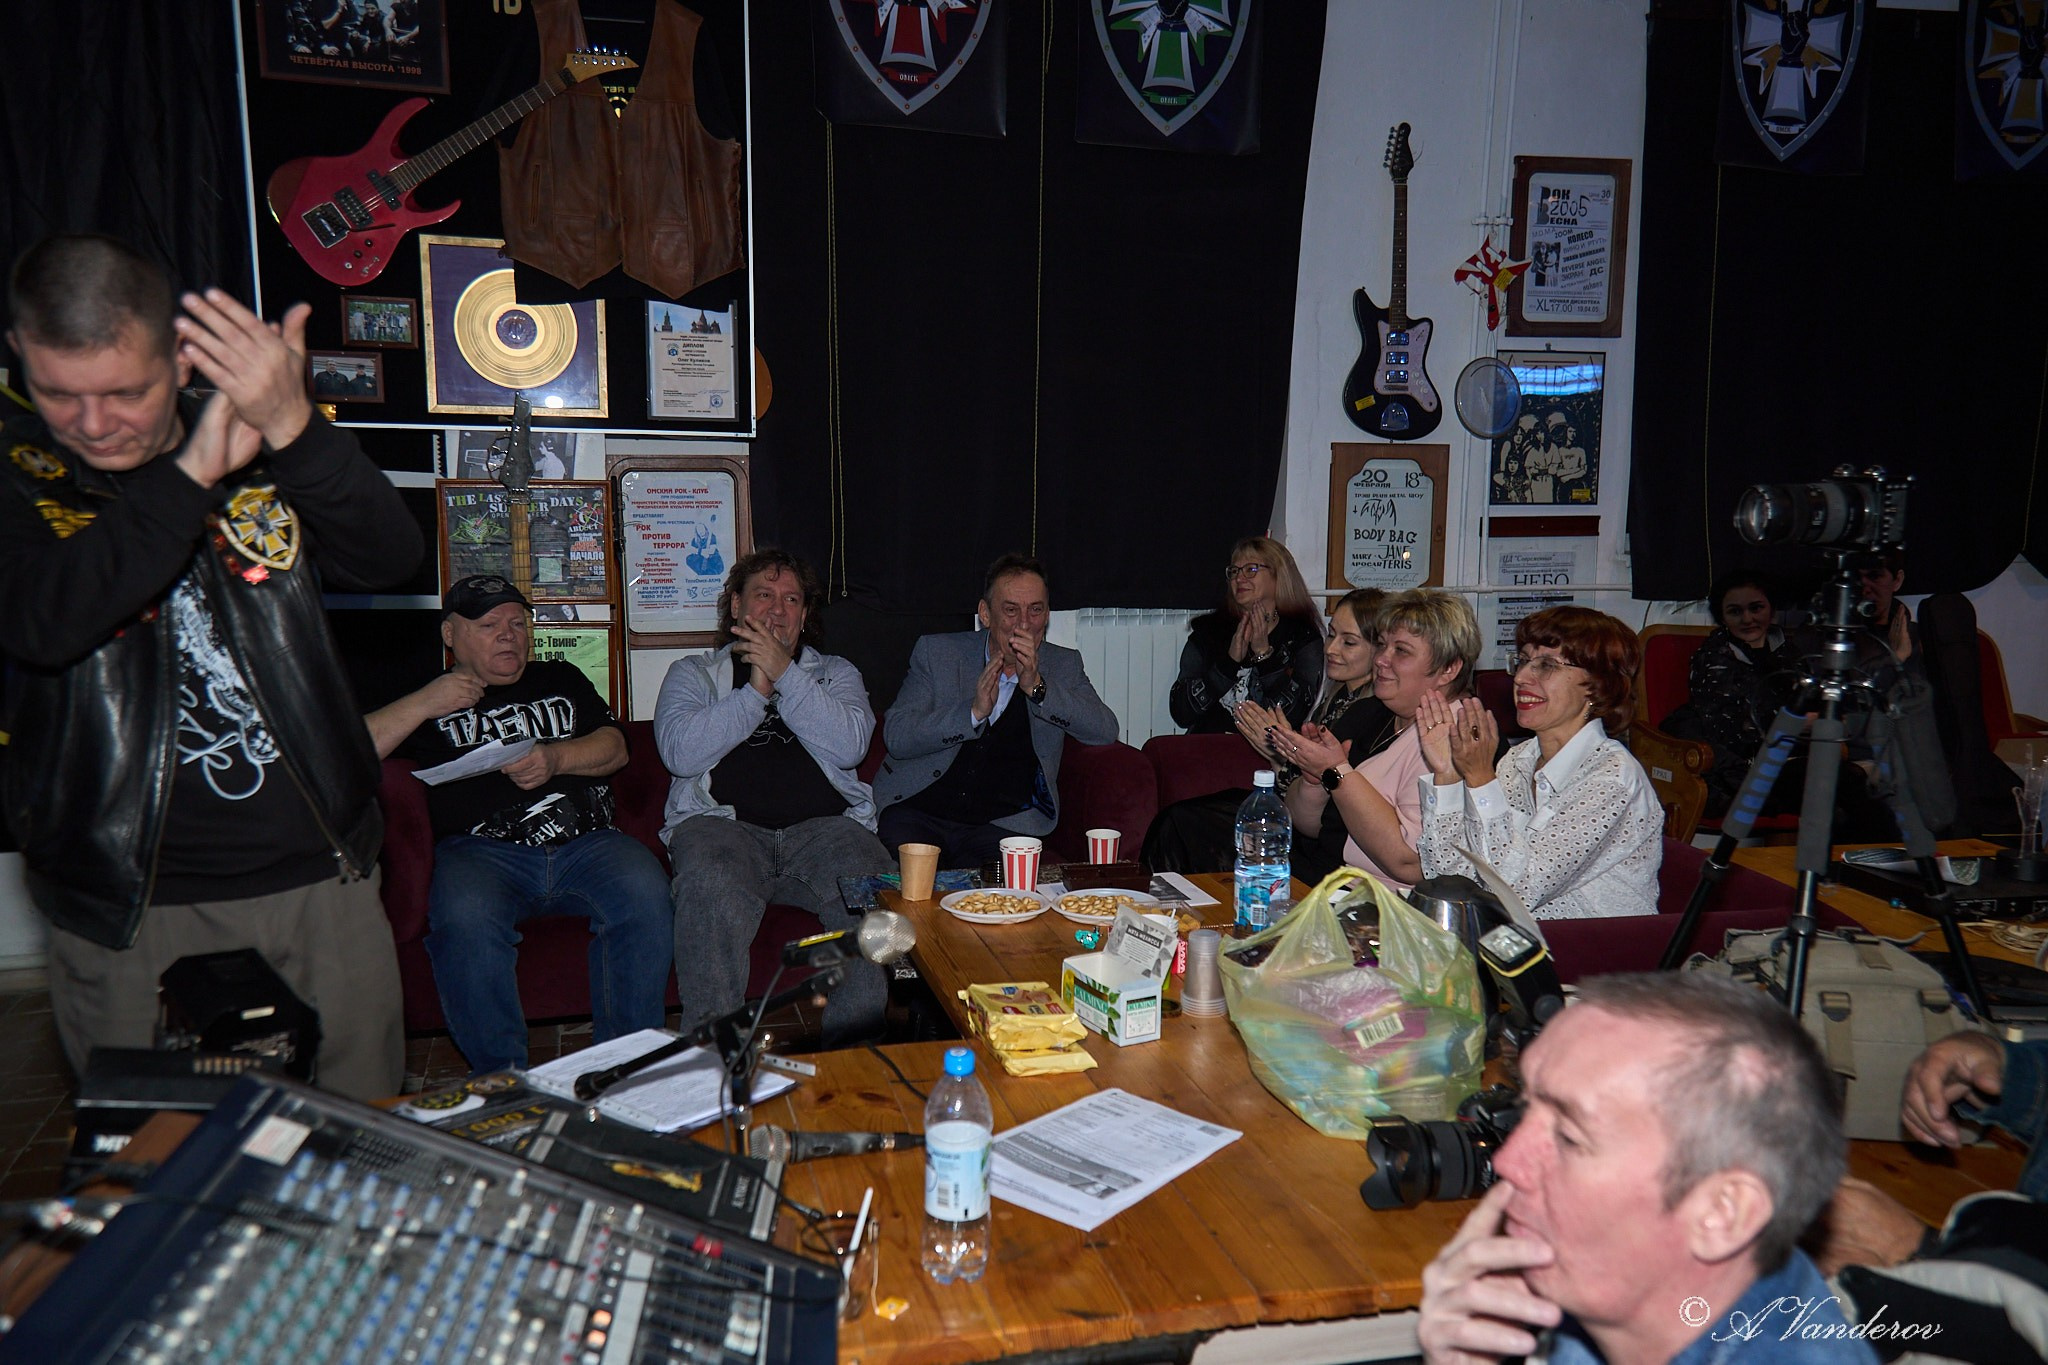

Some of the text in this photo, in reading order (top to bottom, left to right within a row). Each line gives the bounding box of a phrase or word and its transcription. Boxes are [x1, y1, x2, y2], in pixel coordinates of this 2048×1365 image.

[352, 62, 395, 72] ВЫСОТА
[1541, 187, 1570, 203] РОК
[1550, 195, 1590, 217] 2005
[1536, 203, 1577, 225] ВЕСНА
[1567, 230, 1594, 244] КОЛЕСО
[1536, 299, 1549, 311] XL
[1361, 469, 1388, 483] 20
[446, 494, 476, 507] THE
[550, 496, 583, 507] DAYS
[1354, 529, 1417, 543] BODY BAG
[653, 541, 689, 549] ТЕРРОРА"
[570, 551, 605, 561] НАЧАЛО
